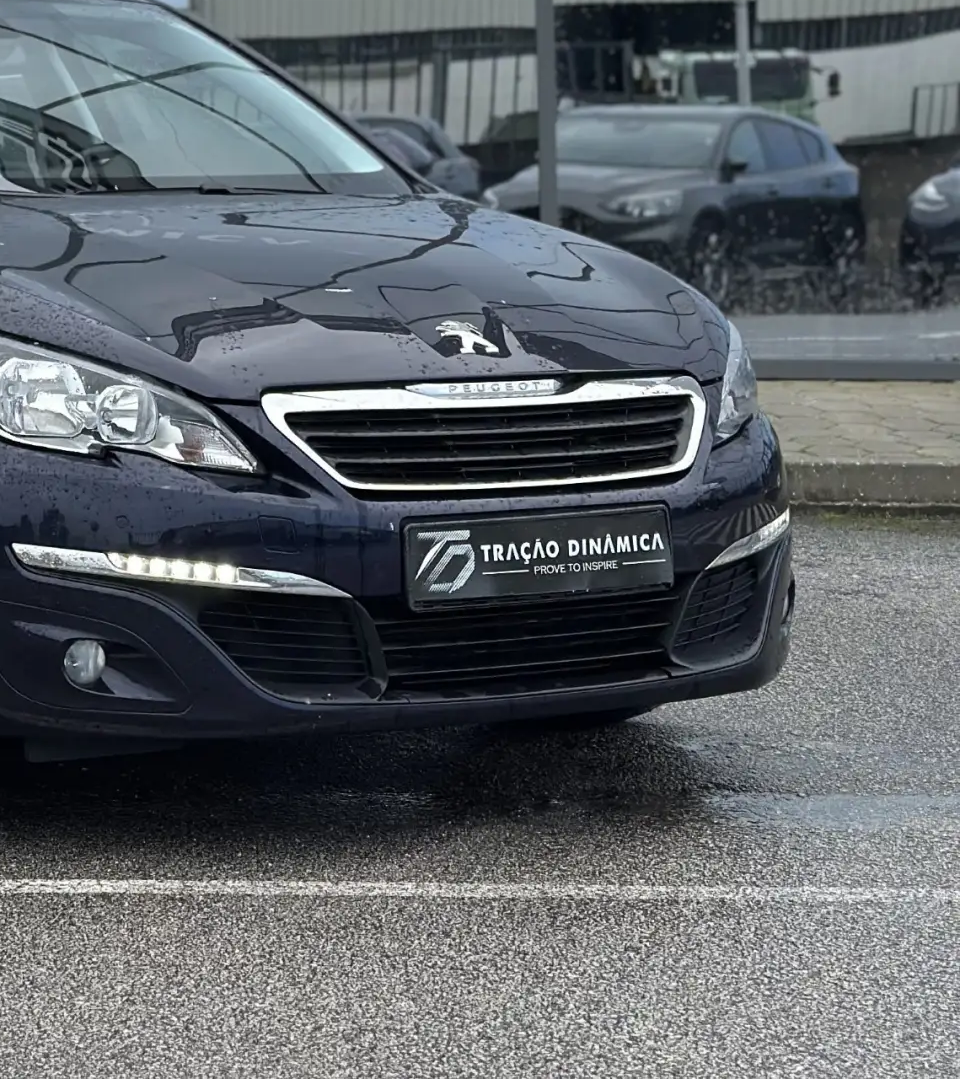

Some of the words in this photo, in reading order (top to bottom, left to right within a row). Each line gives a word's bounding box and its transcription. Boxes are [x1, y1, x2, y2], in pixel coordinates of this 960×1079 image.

[448, 381, 540, 393] PEUGEOT
[480, 538, 560, 564] TRAÇÃO
[568, 532, 665, 557] DINÂMICA
[533, 563, 566, 575] PROVE
[567, 562, 581, 573] TO
[582, 560, 618, 572] INSPIRE
